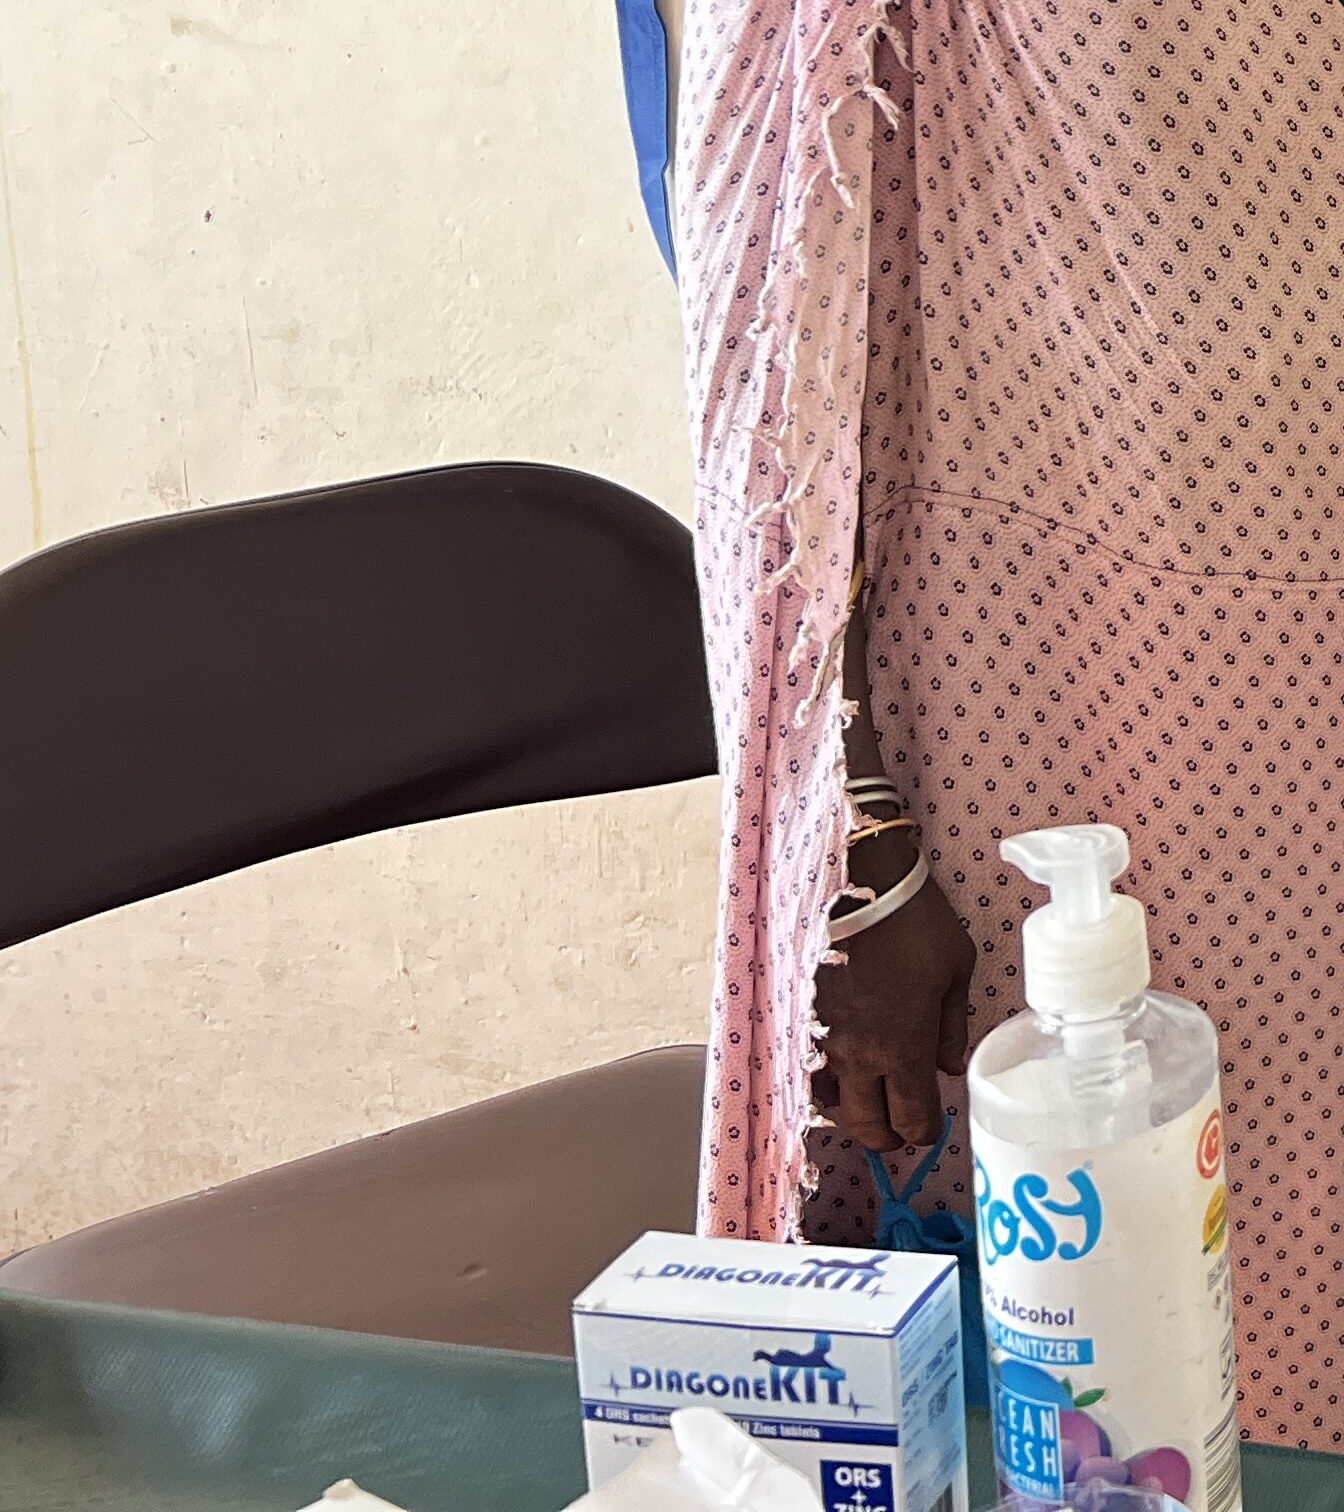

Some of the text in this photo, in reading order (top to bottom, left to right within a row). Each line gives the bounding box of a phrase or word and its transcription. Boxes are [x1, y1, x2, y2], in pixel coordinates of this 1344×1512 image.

[1001, 1298, 1075, 1326] Alcohol
[999, 1332, 1079, 1363] SANITIZER
[834, 1466, 882, 1488] ORS
